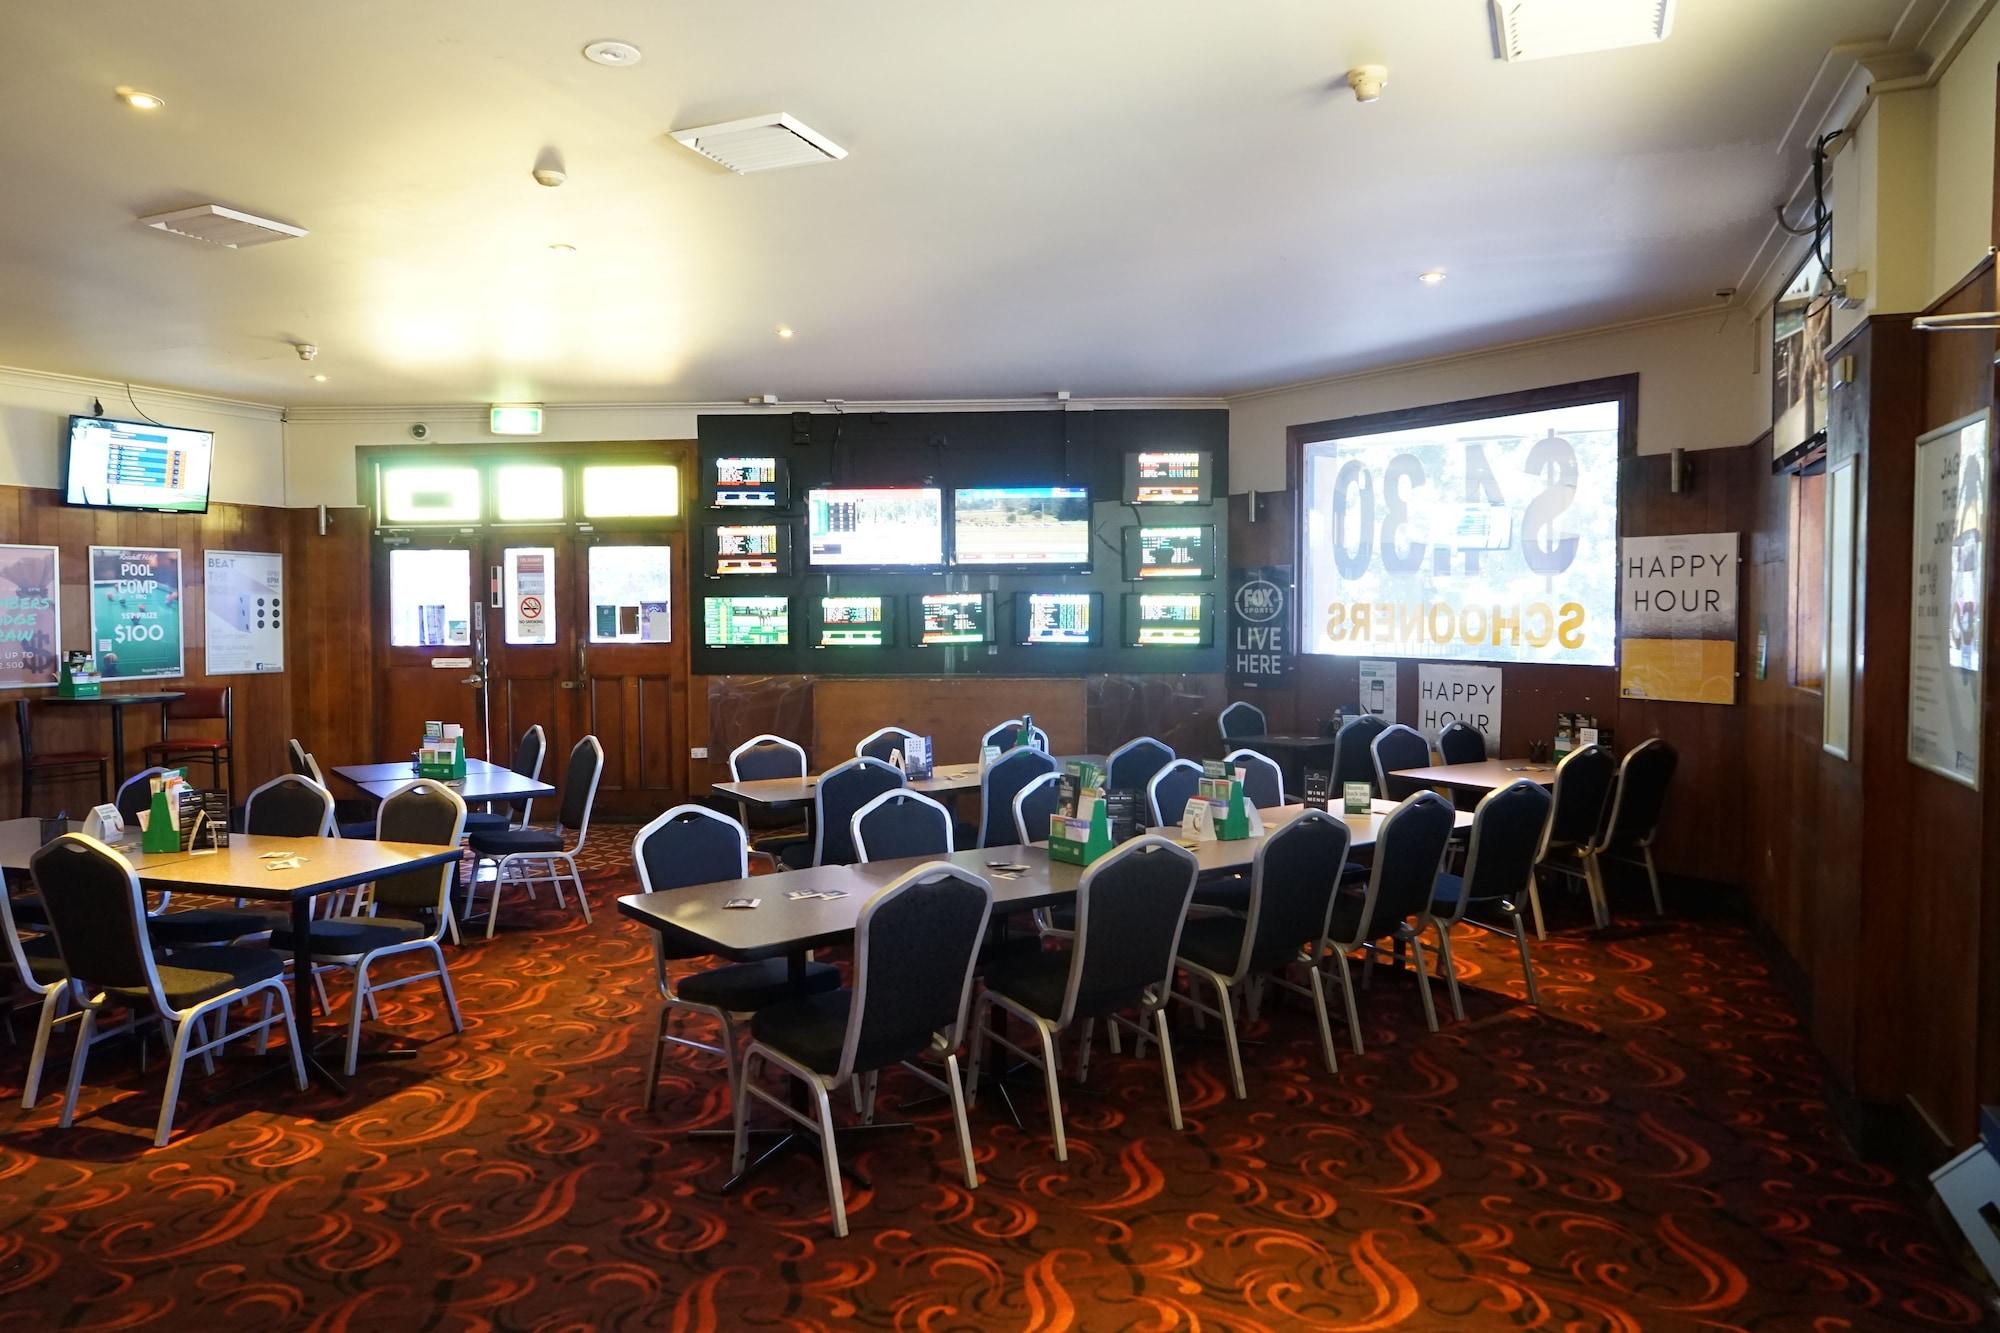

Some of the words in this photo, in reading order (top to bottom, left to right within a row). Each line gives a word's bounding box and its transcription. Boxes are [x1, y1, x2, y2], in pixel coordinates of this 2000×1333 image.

[121, 563, 154, 576] POOL
[208, 558, 235, 568] BEAT
[1629, 554, 1728, 578] HAPPY
[117, 580, 158, 594] COMP
[1244, 588, 1274, 607] FOX
[1635, 589, 1720, 612] HOUR
[114, 624, 164, 644] $100
[1237, 627, 1282, 650] LIVE
[1237, 654, 1281, 675] HERE
[1422, 681, 1495, 704] HAPPY
